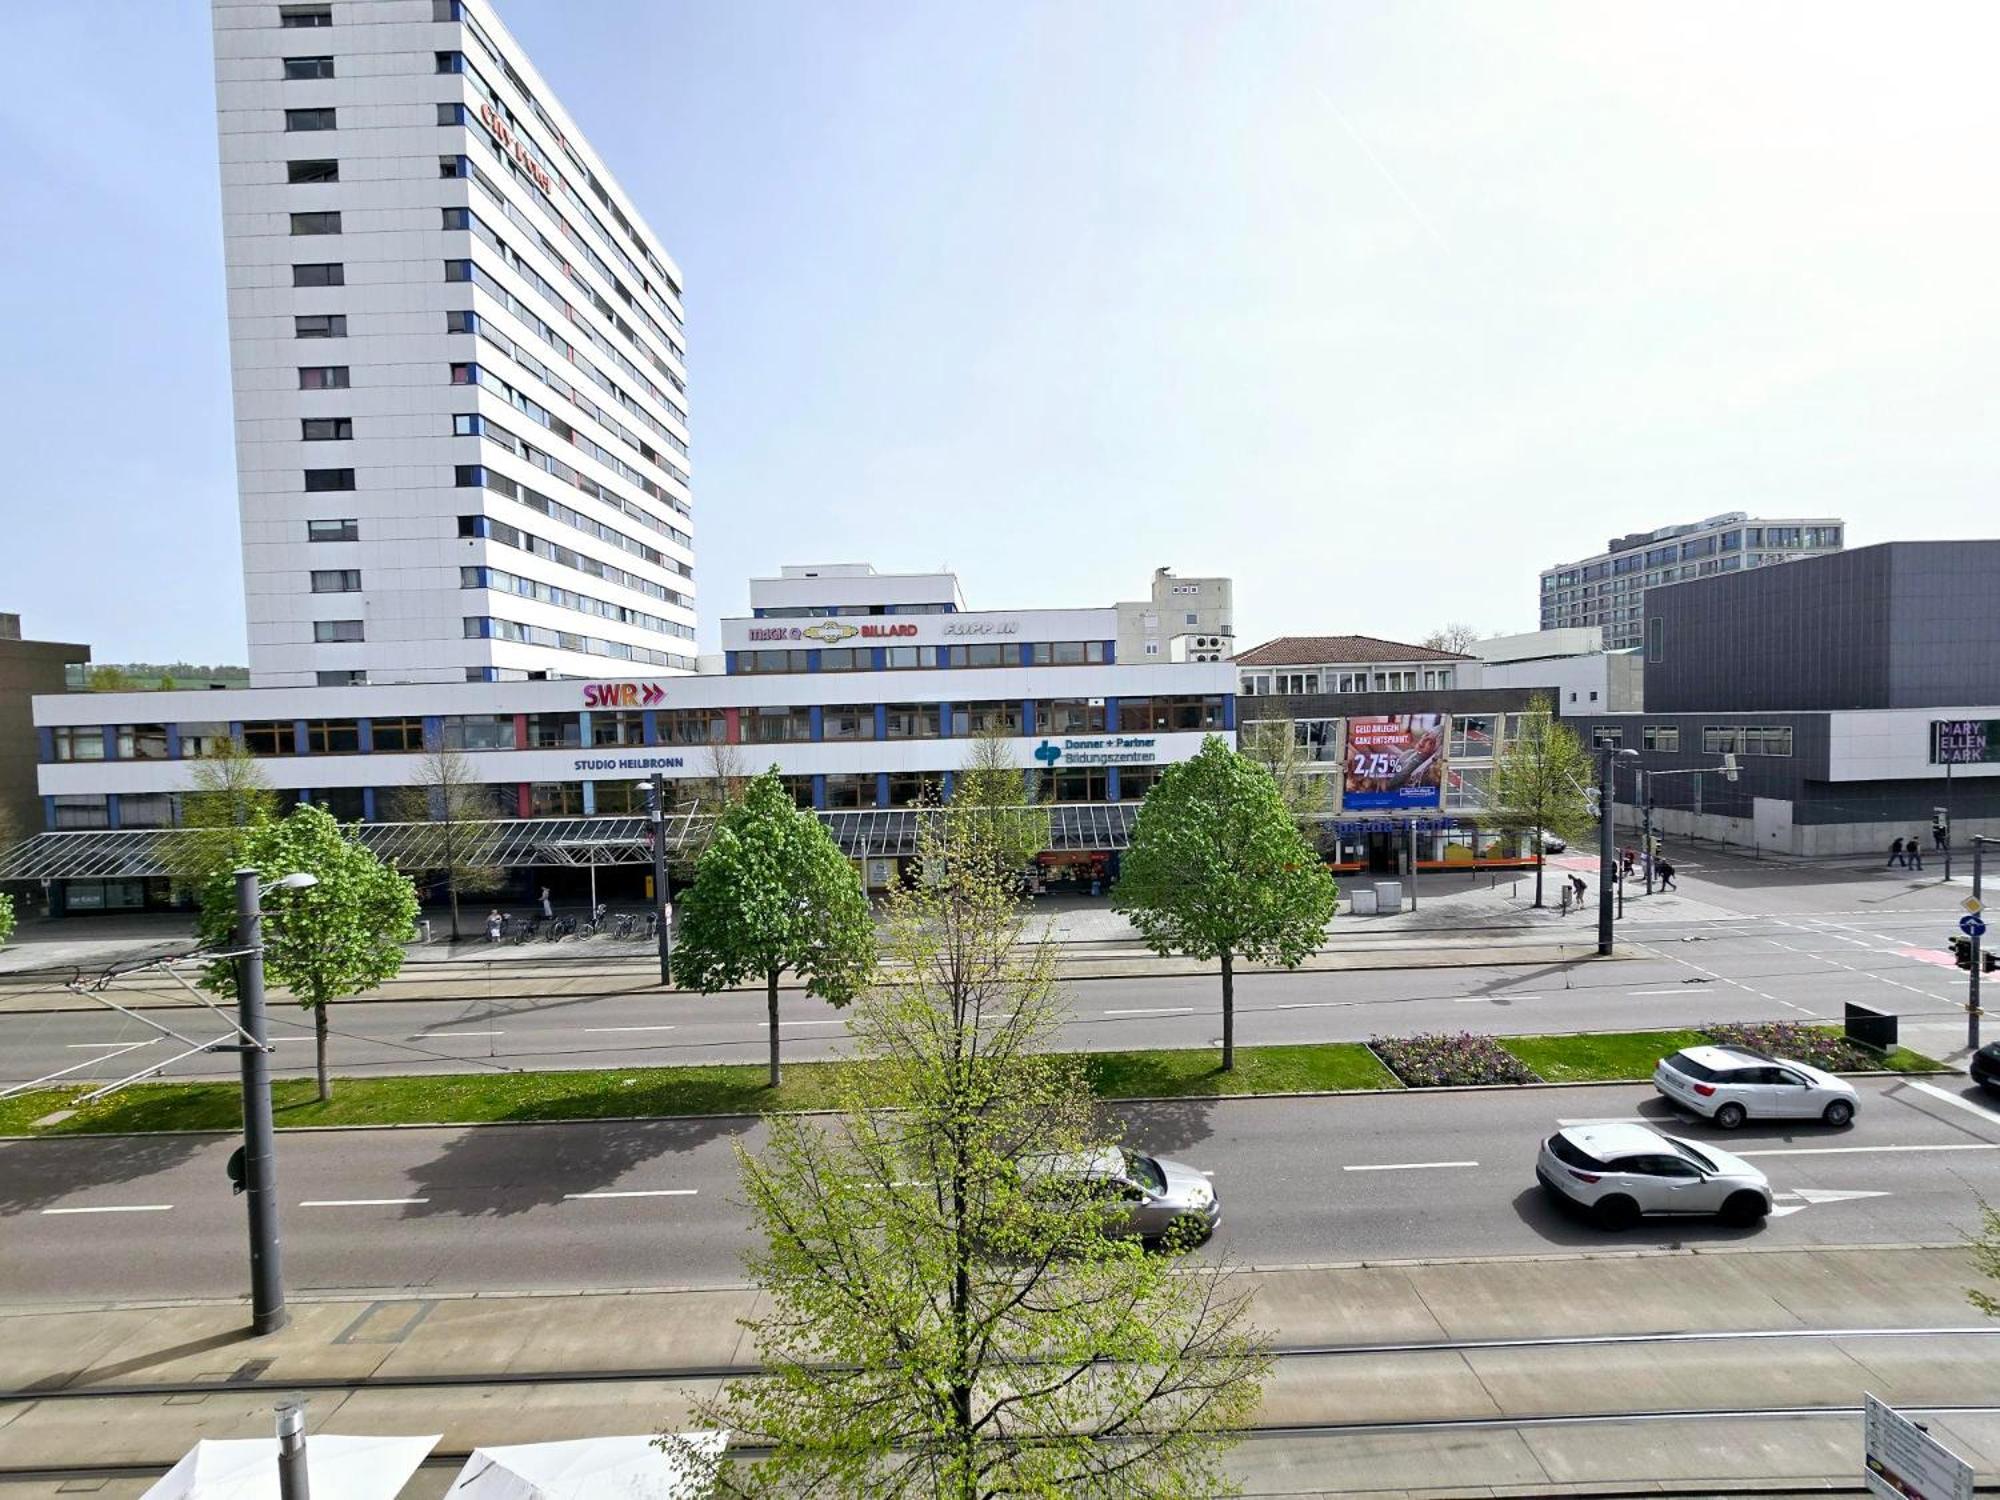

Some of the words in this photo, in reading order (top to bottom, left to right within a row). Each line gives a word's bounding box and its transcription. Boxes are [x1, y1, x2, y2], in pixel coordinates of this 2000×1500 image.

[861, 624, 918, 638] BILLARD
[583, 683, 640, 707] SWR
[1941, 722, 1981, 735] MARY
[1065, 740, 1103, 749] Donner
[1117, 738, 1156, 747] Partner
[1941, 735, 1987, 748] ELLEN
[1065, 751, 1156, 764] Bildungszentren
[1941, 749, 1981, 762] MARK
[574, 759, 616, 770] STUDIO
[619, 757, 684, 769] HEILBRONN
